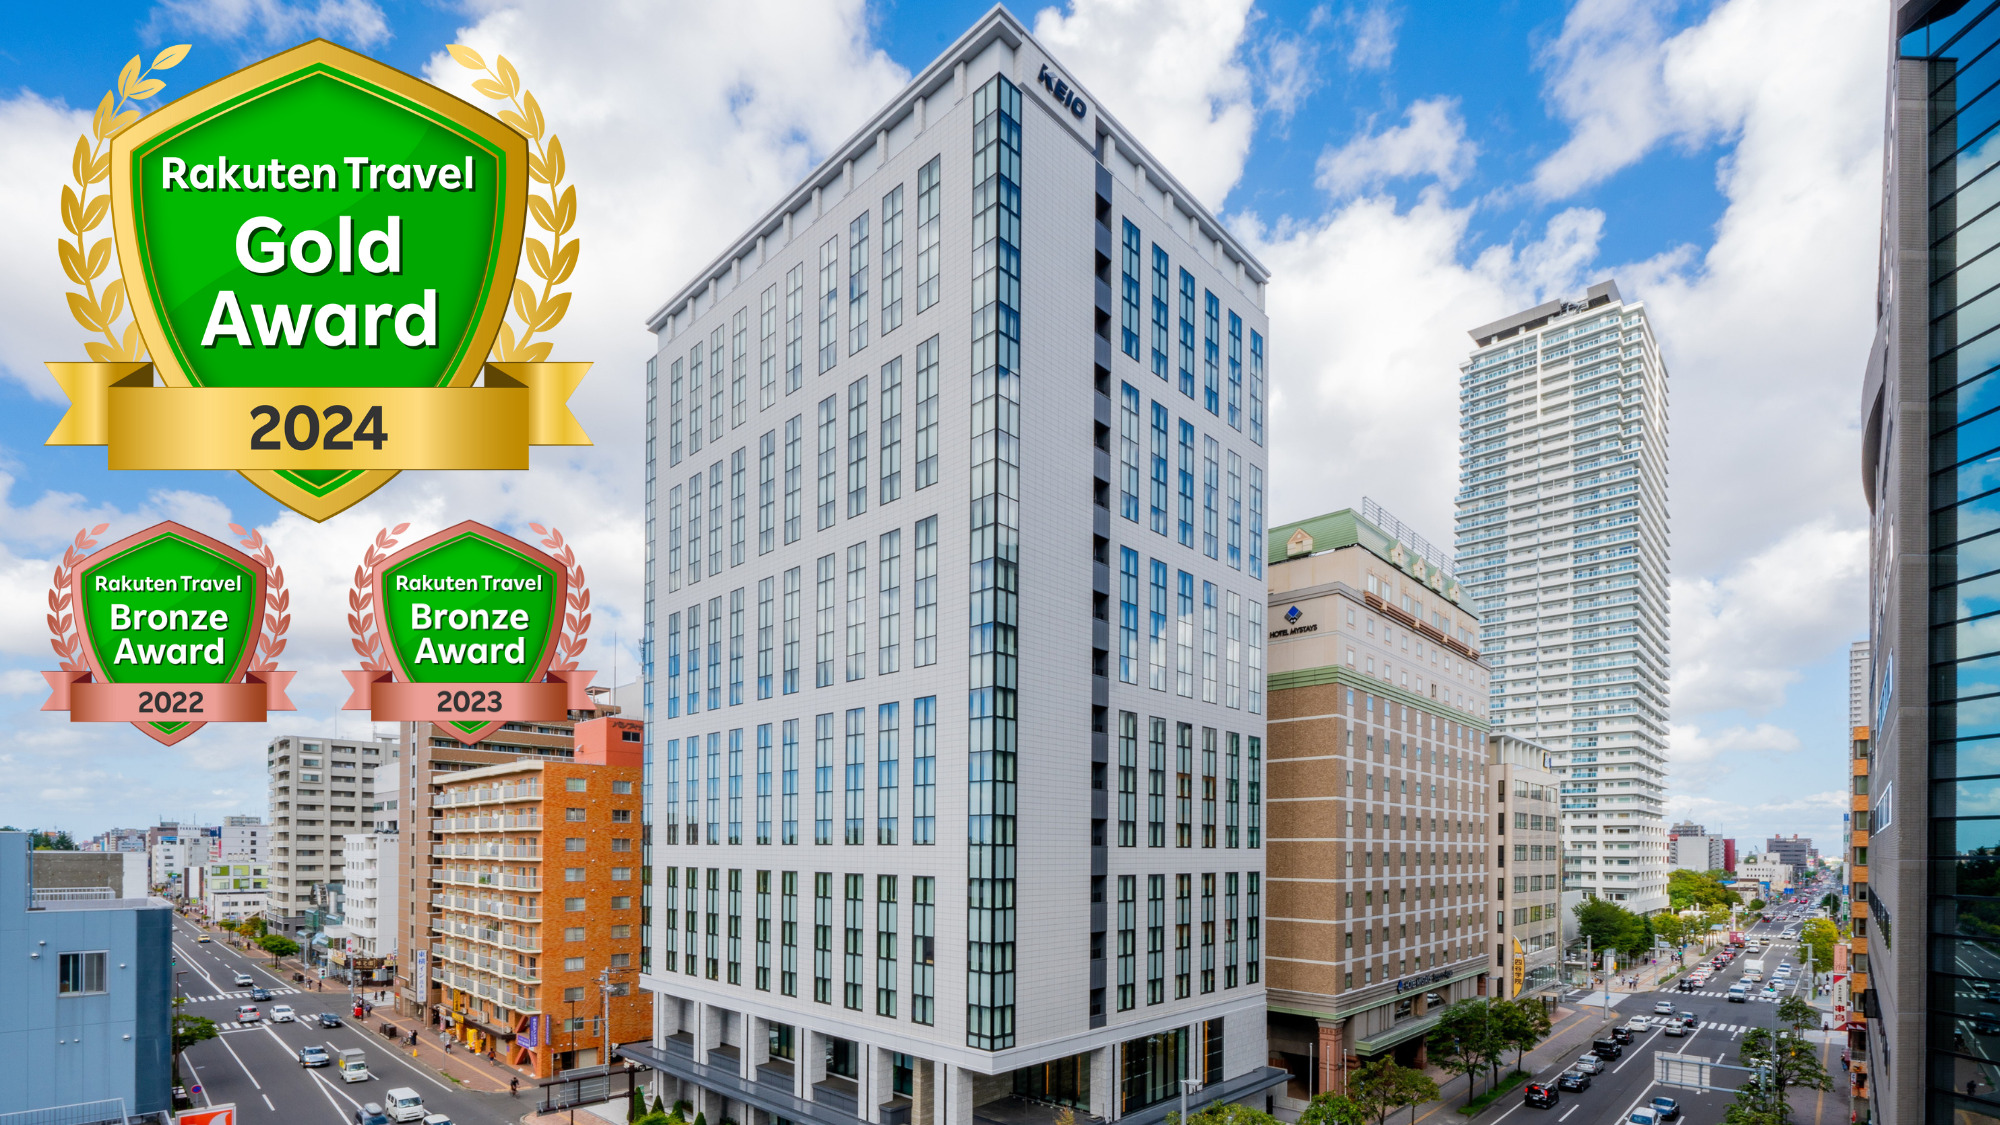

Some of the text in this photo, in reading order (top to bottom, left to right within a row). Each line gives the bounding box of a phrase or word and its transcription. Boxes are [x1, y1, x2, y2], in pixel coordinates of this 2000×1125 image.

[1037, 62, 1087, 119] KEIO
[1269, 624, 1317, 638] HOTEL MYSTAYS
[1514, 959, 1523, 984] 四谷学院
[1834, 1004, 1846, 1022] 串鳥
